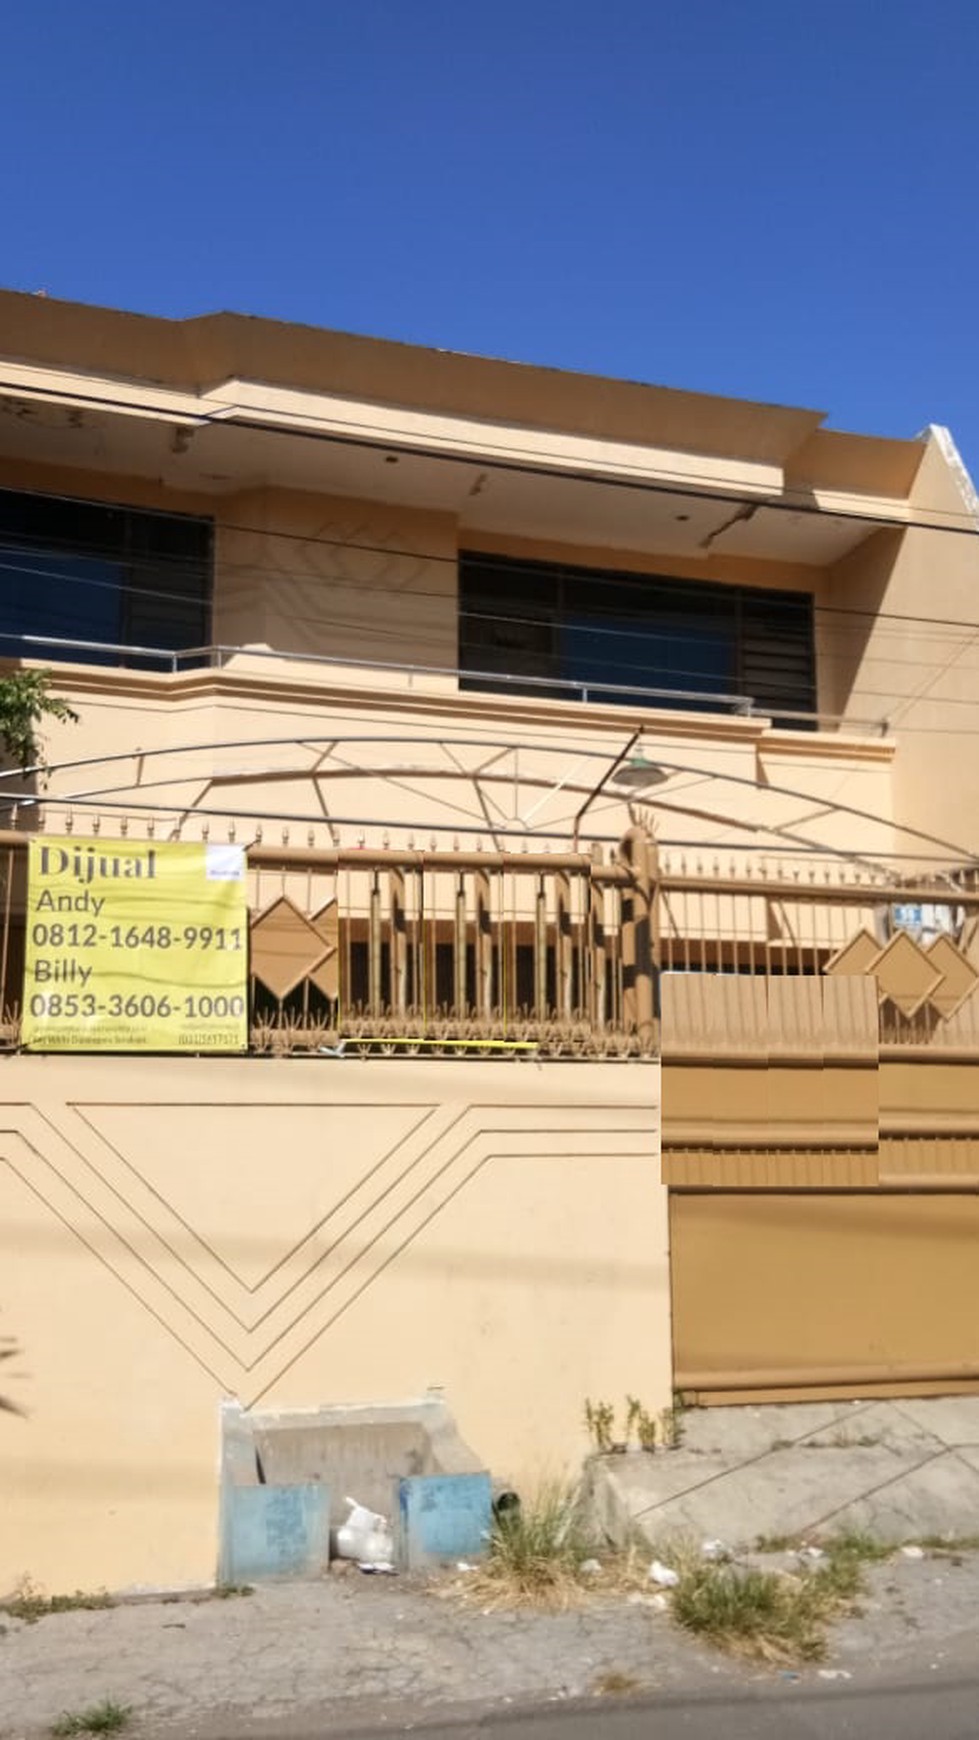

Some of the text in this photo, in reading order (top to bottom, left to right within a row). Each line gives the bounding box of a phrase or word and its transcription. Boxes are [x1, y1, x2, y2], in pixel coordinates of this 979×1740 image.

[39, 845, 156, 884] Dijual
[36, 889, 106, 917] Andy
[32, 923, 242, 950] 0812-1648-9911
[34, 959, 93, 987] Billy
[30, 993, 244, 1018] 0853-3606-1000
